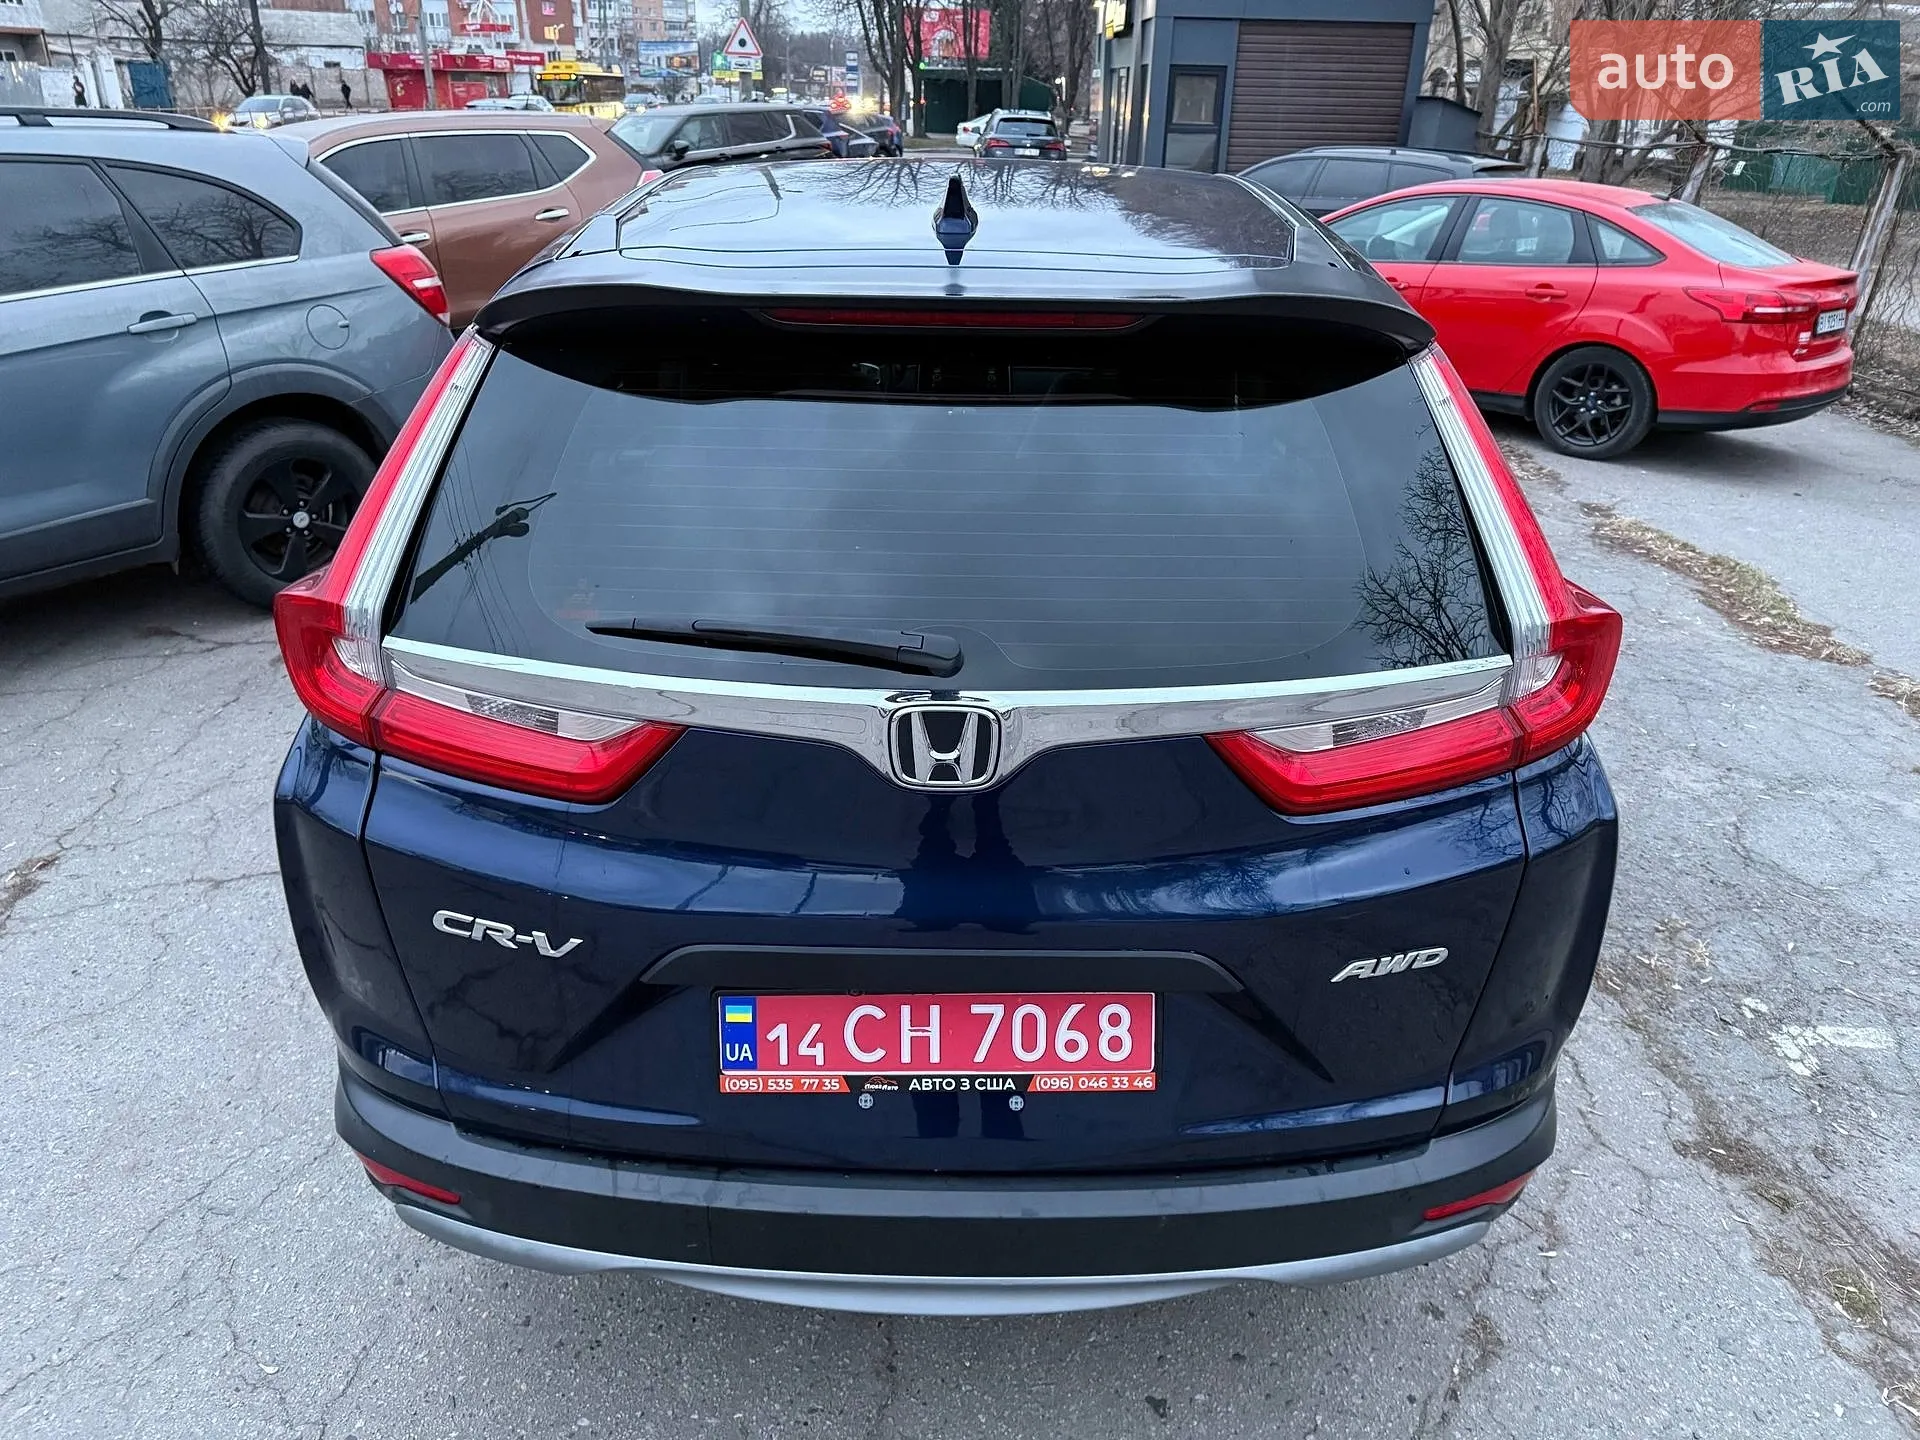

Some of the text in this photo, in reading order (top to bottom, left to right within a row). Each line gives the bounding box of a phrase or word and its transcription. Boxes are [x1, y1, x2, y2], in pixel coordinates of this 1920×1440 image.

[432, 909, 584, 958] CR-V
[1330, 947, 1449, 982] AWD
[765, 1003, 1133, 1066] 14 CH 7068
[725, 1044, 753, 1062] UA
[725, 1078, 840, 1091] (095) 535 77 35
[908, 1078, 955, 1091] АВТО
[974, 1078, 1016, 1091] США
[1036, 1076, 1153, 1091] (096) 046 33 46
